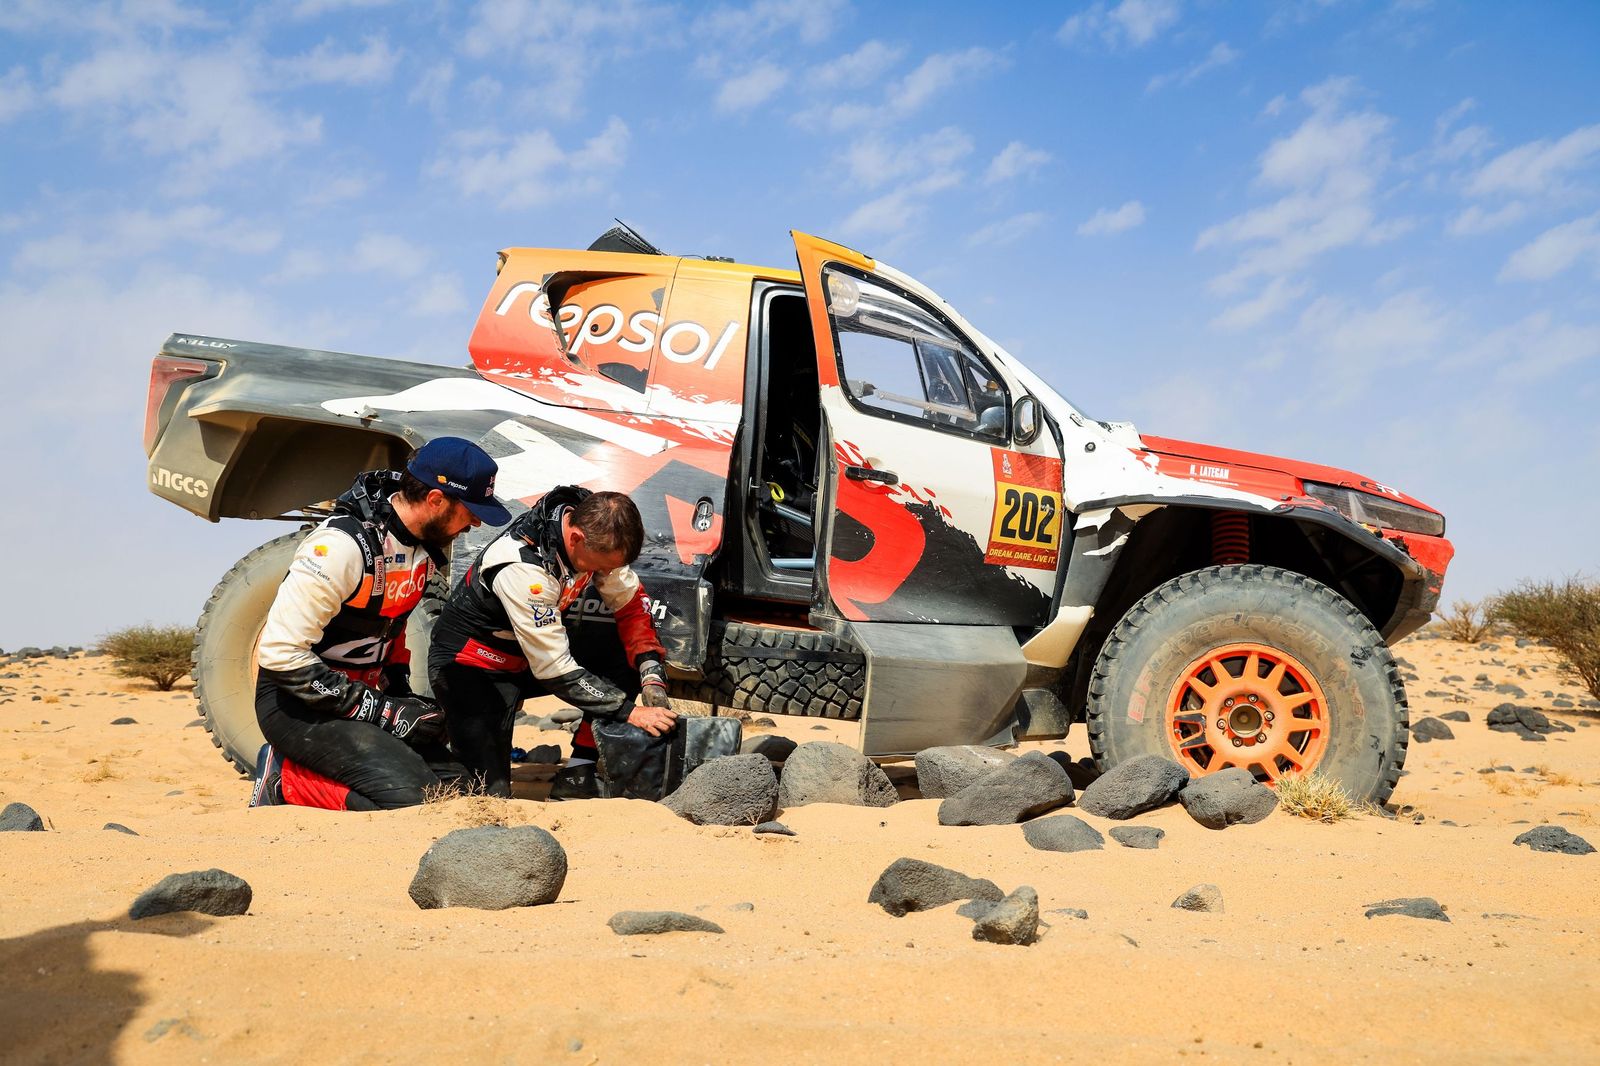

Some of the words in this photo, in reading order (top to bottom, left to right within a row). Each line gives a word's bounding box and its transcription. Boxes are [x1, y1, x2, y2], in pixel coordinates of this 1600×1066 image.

[496, 282, 741, 371] repsol
[447, 480, 468, 491] repsol
[1000, 488, 1056, 544] 202
[356, 533, 374, 567] sparco
[989, 548, 1013, 560] DREAM.
[1014, 551, 1032, 562] DARE.
[1033, 554, 1048, 564] LIVE
[375, 560, 384, 592] SIMPSON
[534, 616, 557, 628] USN
[476, 647, 506, 664] sparco
[311, 680, 341, 697] sparco
[578, 679, 605, 698] sparco
